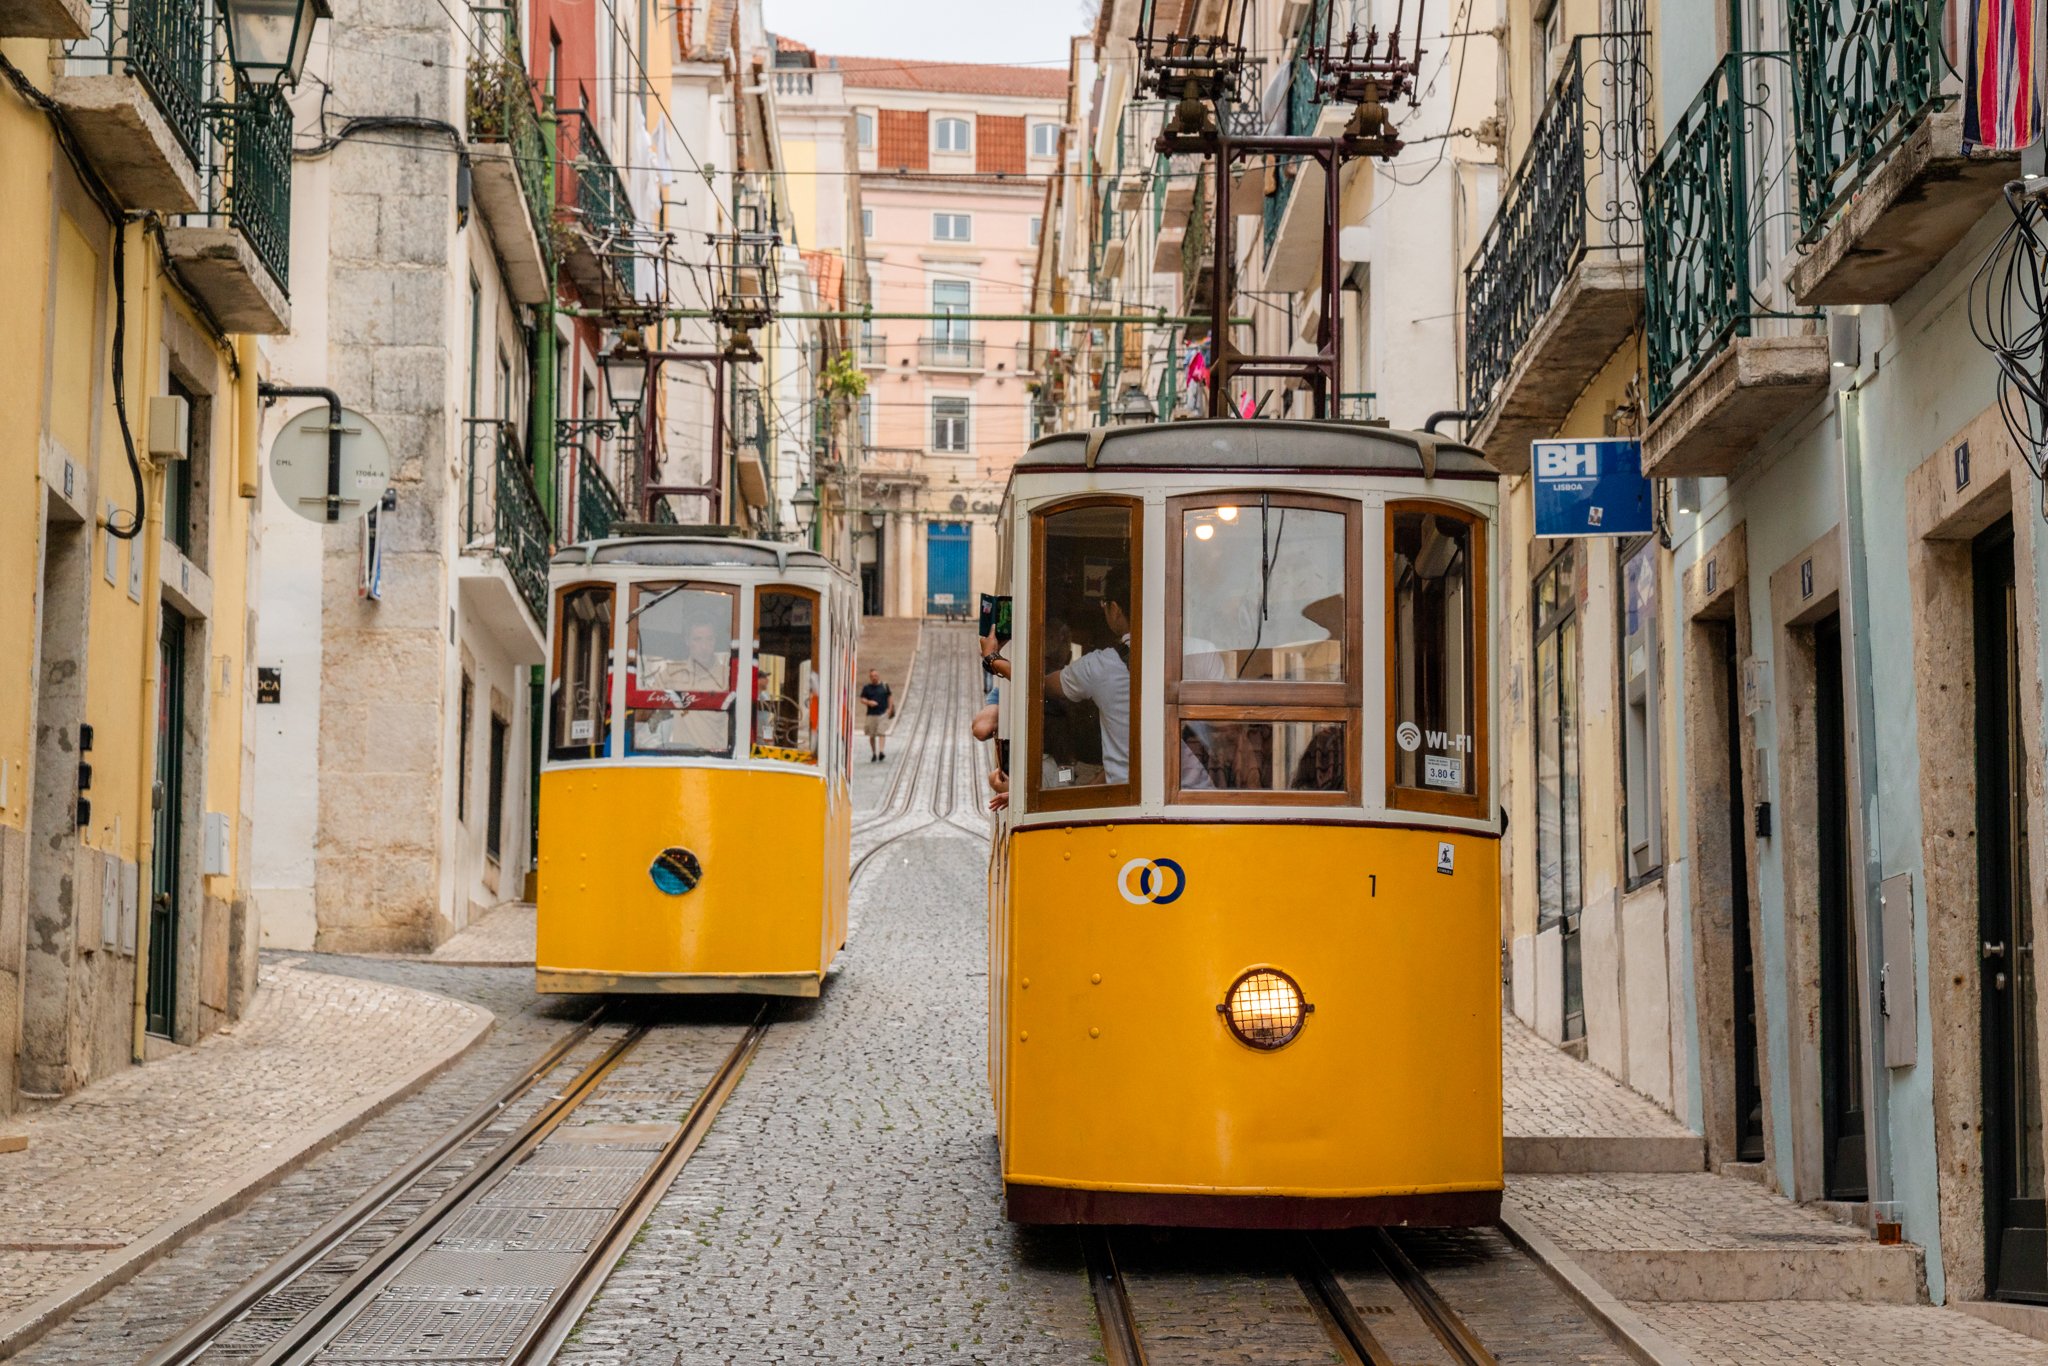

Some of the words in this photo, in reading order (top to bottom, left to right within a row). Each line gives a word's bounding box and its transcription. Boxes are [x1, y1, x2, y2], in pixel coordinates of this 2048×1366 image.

[1537, 444, 1597, 477] BH
[1958, 447, 1965, 484] 6
[1553, 483, 1583, 491] LISBOA
[1425, 730, 1471, 753] WI-FI
[1430, 768, 1448, 779] 3.80
[1449, 770, 1456, 780] €
[1368, 875, 1376, 898] 1
